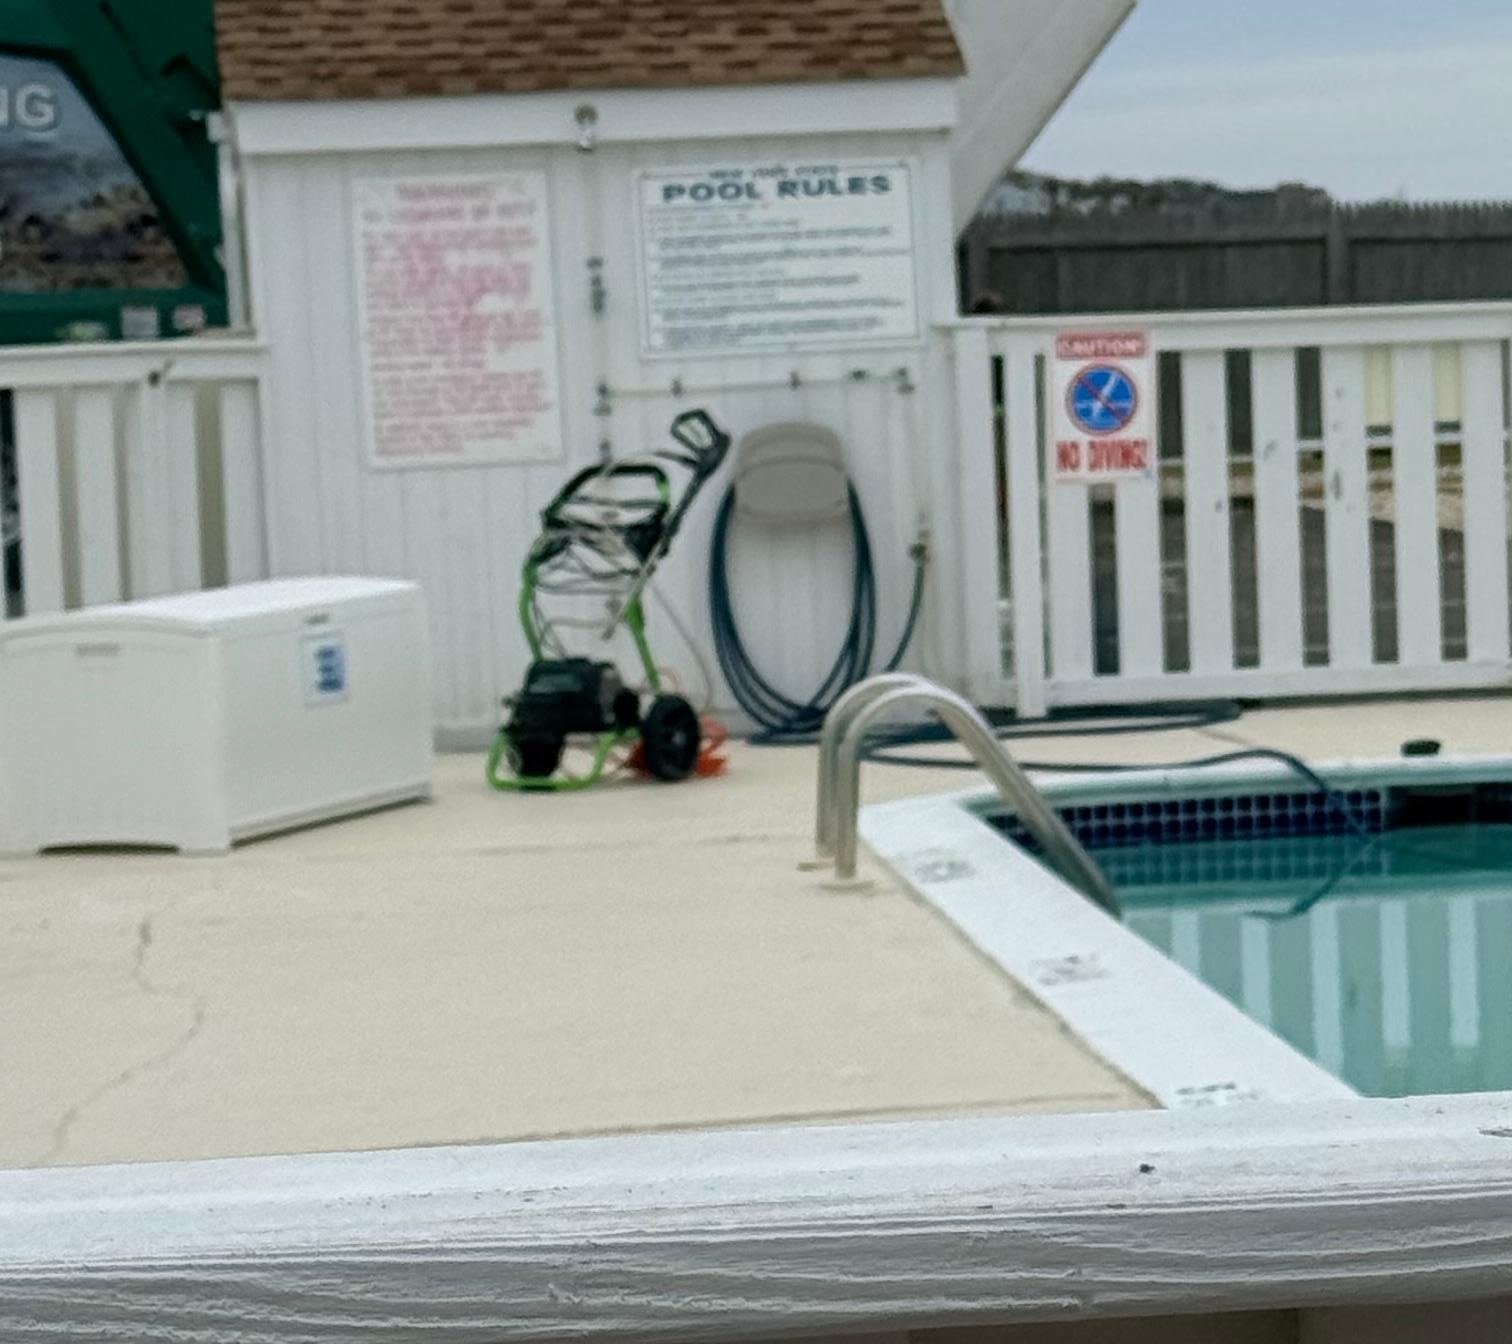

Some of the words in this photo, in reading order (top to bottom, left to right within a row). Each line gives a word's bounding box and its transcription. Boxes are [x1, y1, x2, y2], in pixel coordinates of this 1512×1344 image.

[661, 182, 761, 201] POOL
[777, 175, 891, 197] RULES
[1057, 441, 1080, 472] NO
